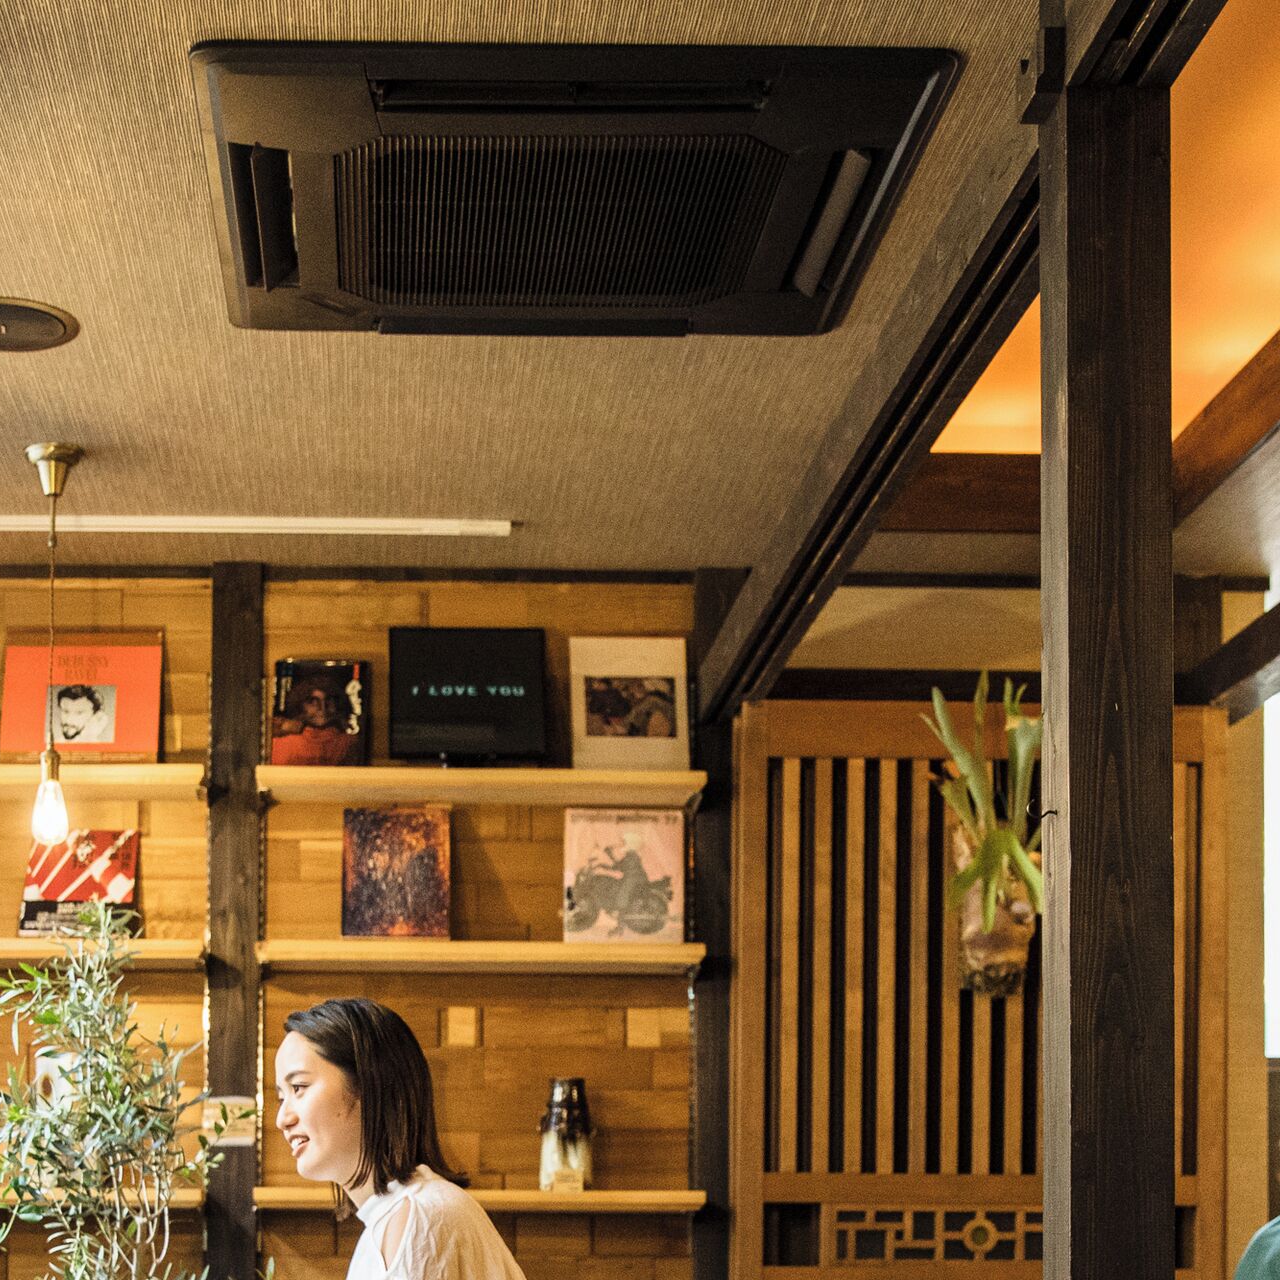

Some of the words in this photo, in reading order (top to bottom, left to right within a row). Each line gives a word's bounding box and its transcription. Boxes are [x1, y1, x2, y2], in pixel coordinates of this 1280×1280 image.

[411, 684, 420, 697] I
[428, 684, 478, 697] LOVE
[486, 684, 526, 697] YOU
